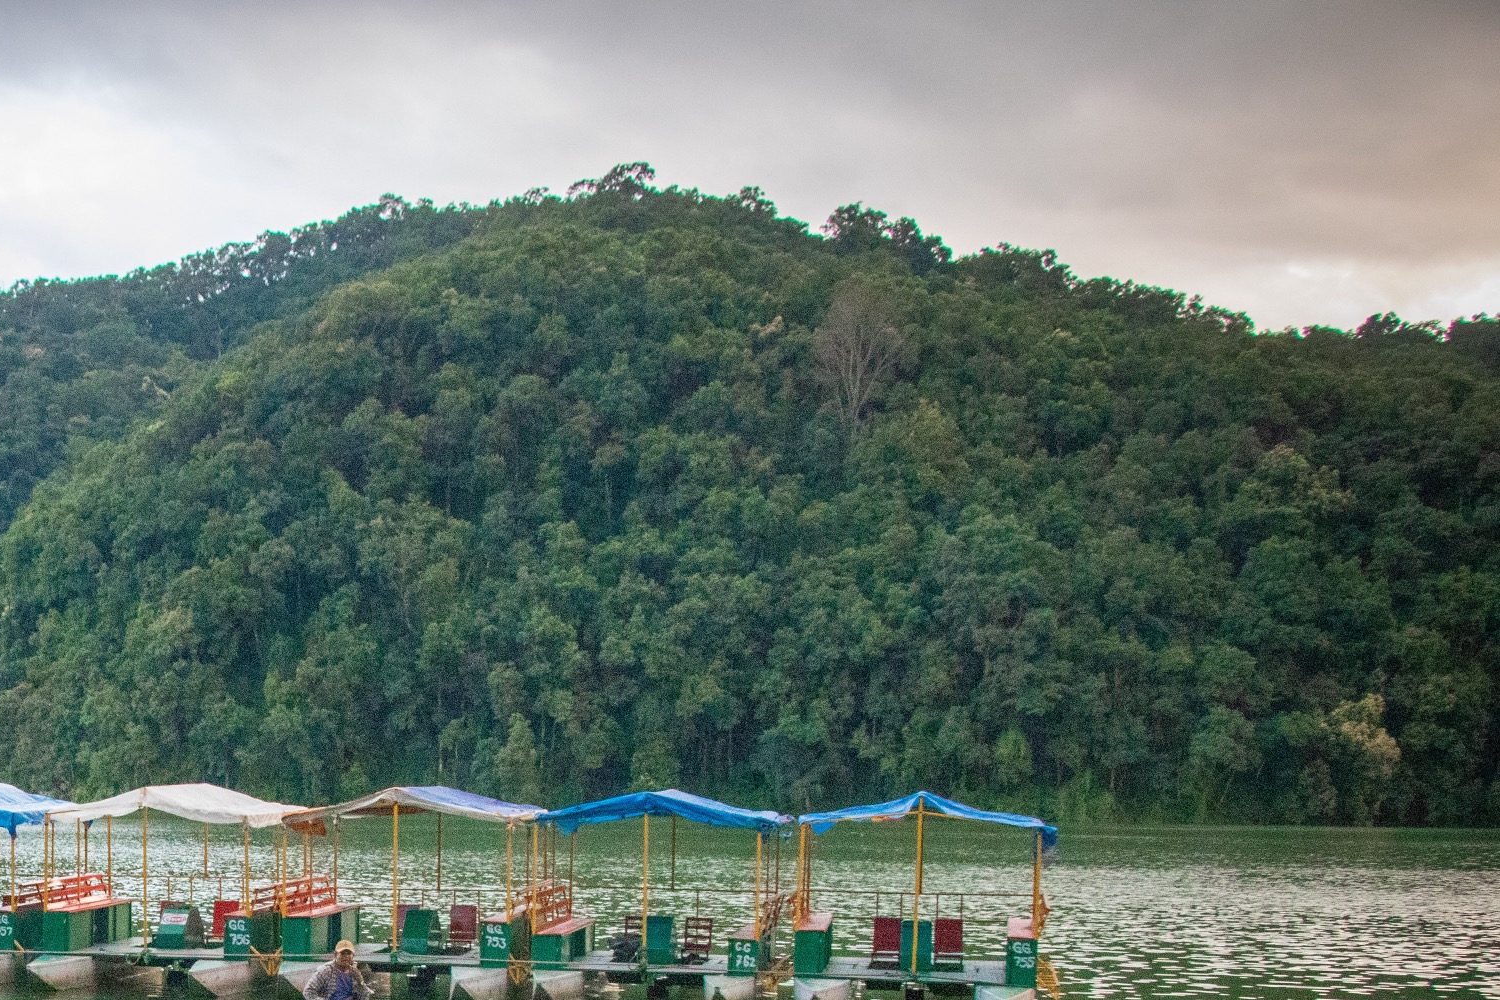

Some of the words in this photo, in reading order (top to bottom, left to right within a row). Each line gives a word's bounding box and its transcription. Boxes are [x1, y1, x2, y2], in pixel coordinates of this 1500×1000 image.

[228, 919, 247, 931] GG
[486, 924, 504, 935] GG
[229, 933, 251, 946] 756
[485, 935, 507, 949] 753
[1011, 941, 1033, 954] GG
[735, 954, 756, 968] 762
[1013, 956, 1036, 969] 755
